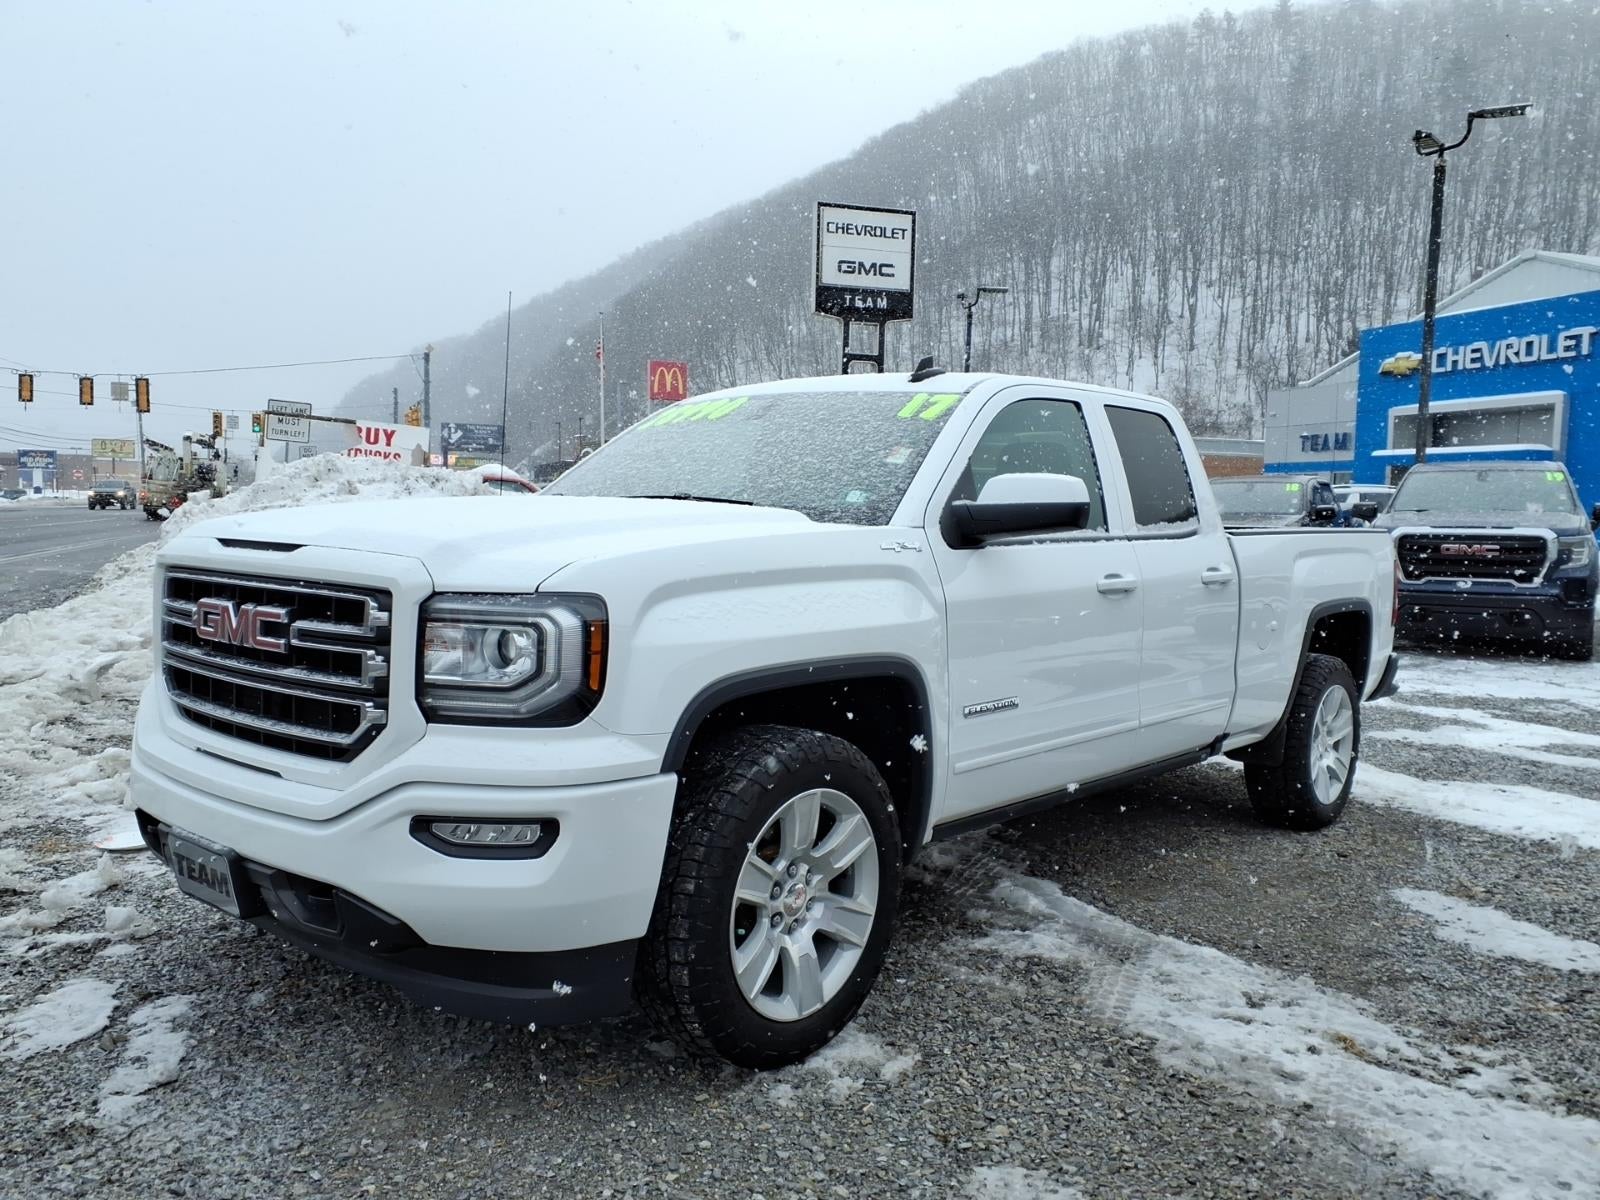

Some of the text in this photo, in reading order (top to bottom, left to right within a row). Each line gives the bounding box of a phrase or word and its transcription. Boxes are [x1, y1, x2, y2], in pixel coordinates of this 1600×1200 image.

[826, 221, 908, 240] CHEVROLET
[837, 259, 896, 278] GMC
[844, 295, 888, 309] TEAM
[1431, 325, 1598, 374] CHEVROLET
[271, 404, 308, 415] LEFT LANE
[896, 392, 961, 421] 17
[277, 416, 301, 427] MUST
[271, 427, 306, 438] TURN LEFT
[1299, 431, 1351, 453] TEAM
[1440, 543, 1501, 556] GMC
[195, 597, 292, 654] GMC
[966, 697, 1018, 716] ELEVATION
[173, 851, 231, 898] TEAM
